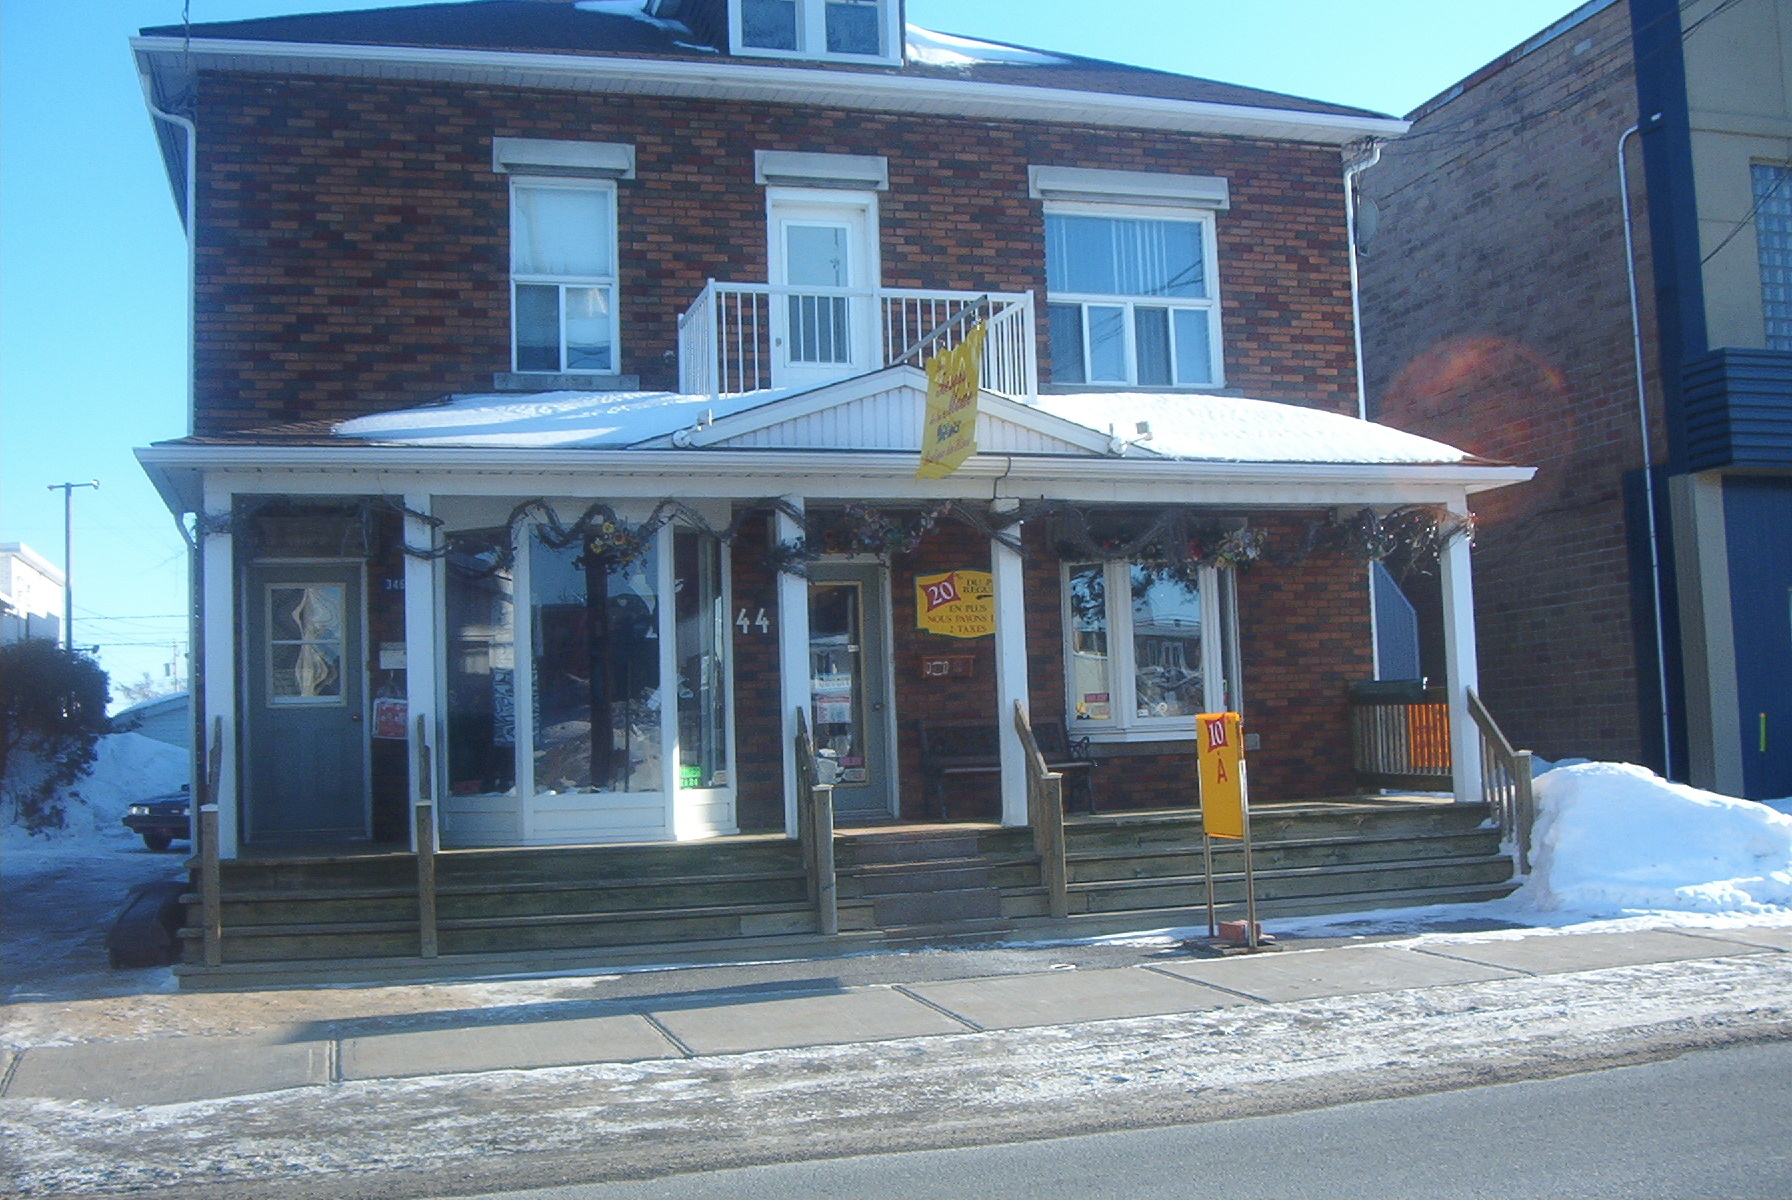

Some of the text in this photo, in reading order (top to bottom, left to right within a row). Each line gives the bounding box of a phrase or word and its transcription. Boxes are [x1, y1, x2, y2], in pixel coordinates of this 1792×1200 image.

[928, 581, 954, 605] 20
[949, 604, 988, 613] EN PLUS
[736, 608, 770, 634] 44
[927, 615, 952, 624] NOUS
[956, 614, 987, 624] PAYONS
[957, 624, 987, 633] TAXES
[1209, 721, 1224, 746] 10
